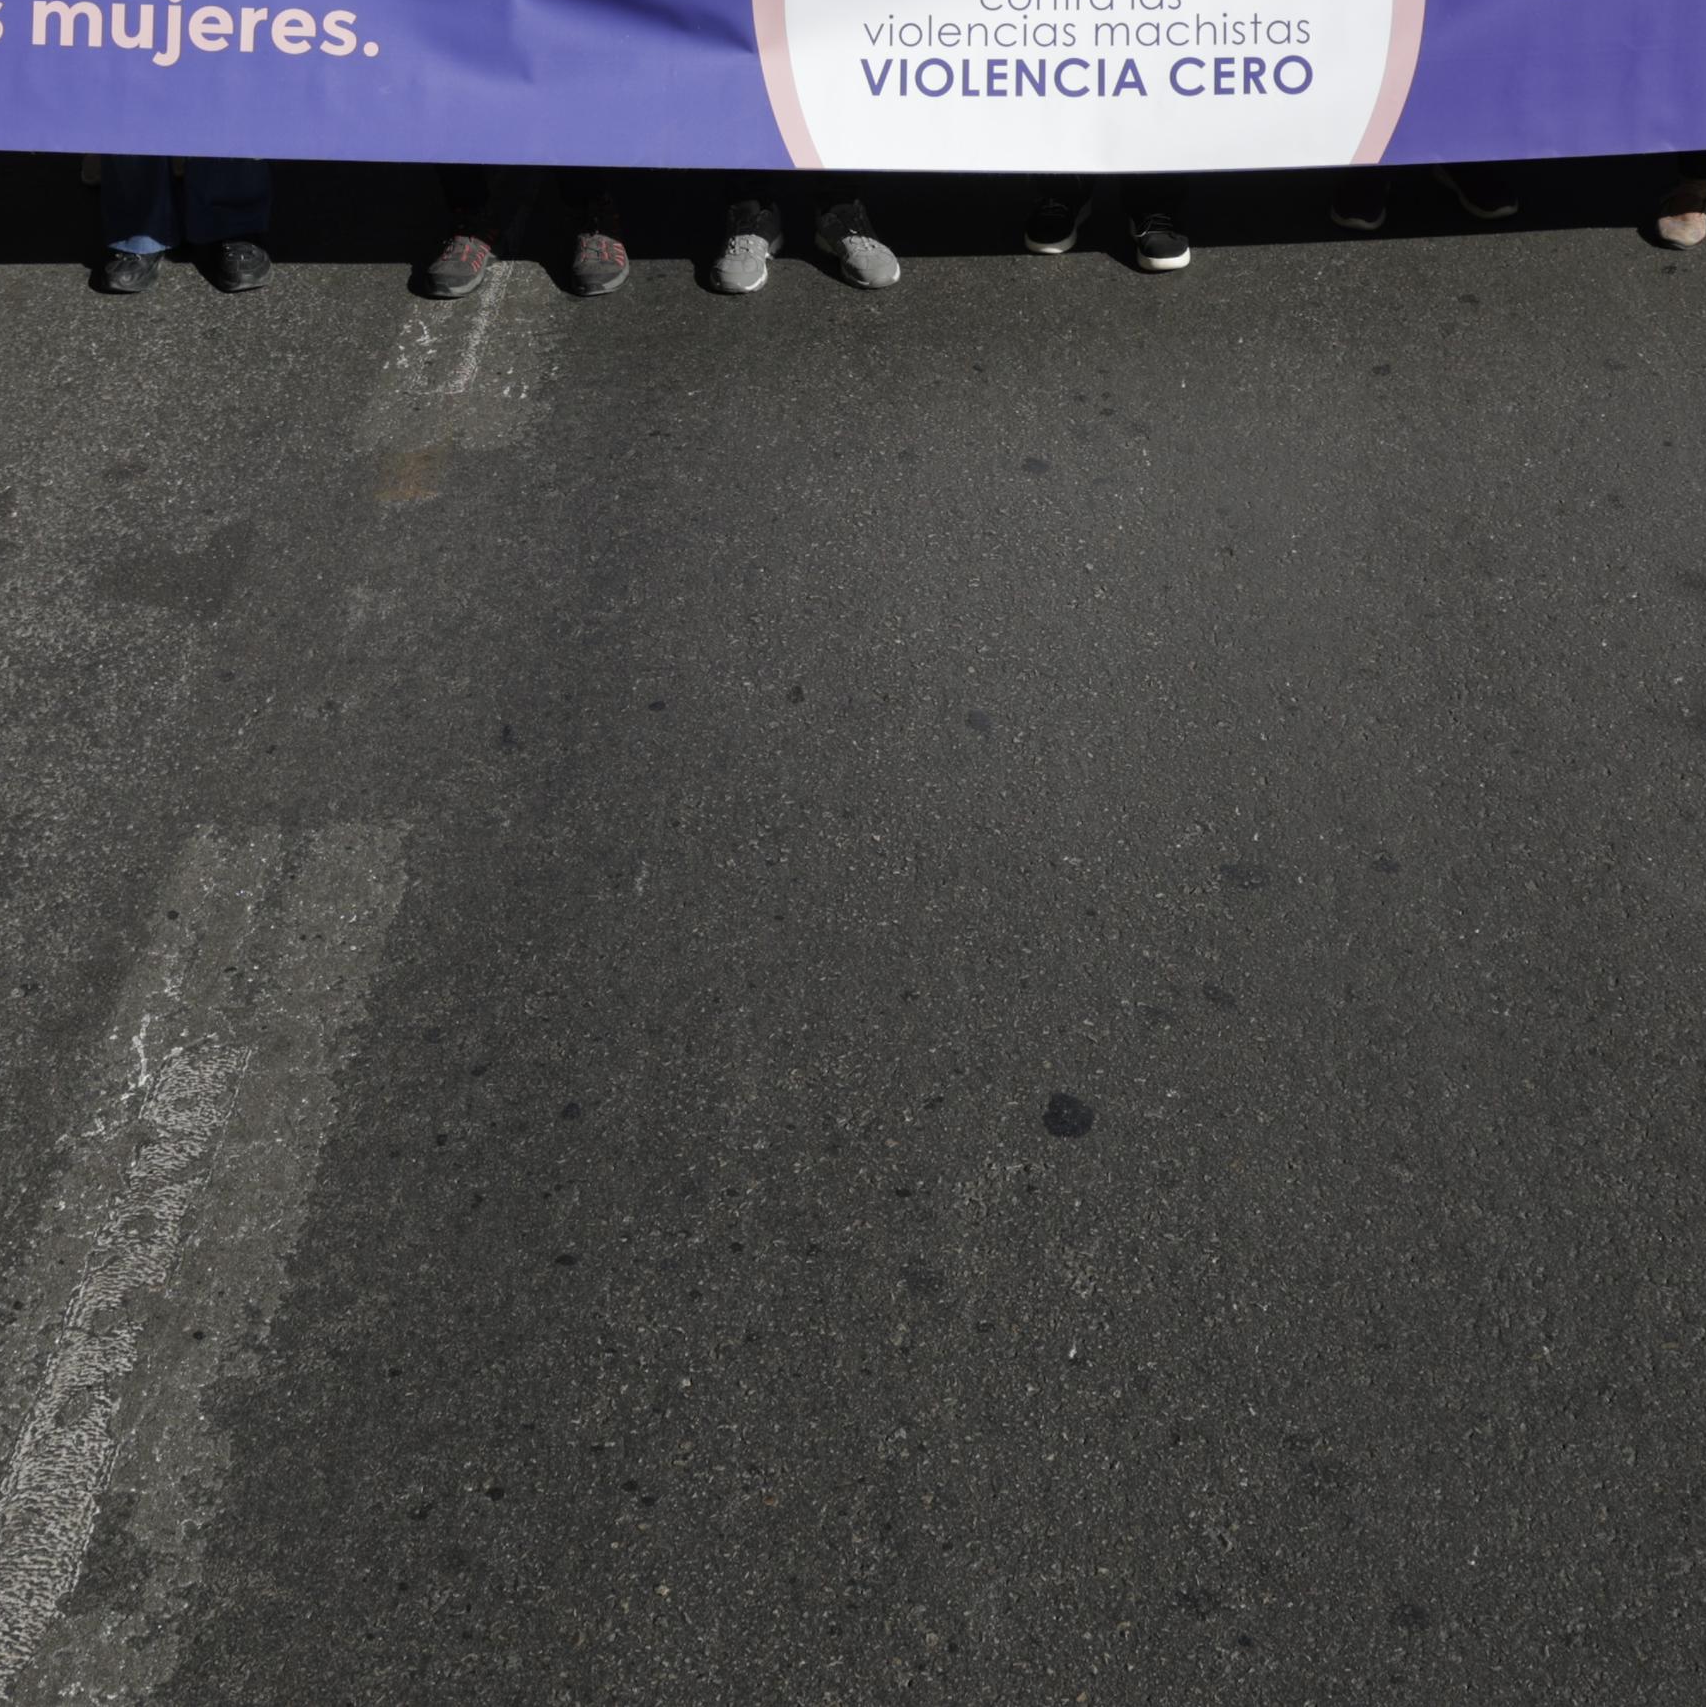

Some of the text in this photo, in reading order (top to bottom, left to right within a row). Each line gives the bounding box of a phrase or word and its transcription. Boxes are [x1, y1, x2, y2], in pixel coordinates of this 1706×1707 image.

[863, 12, 1311, 48] violencias machistas
[861, 54, 1313, 97] VIOLENCIA CERO
